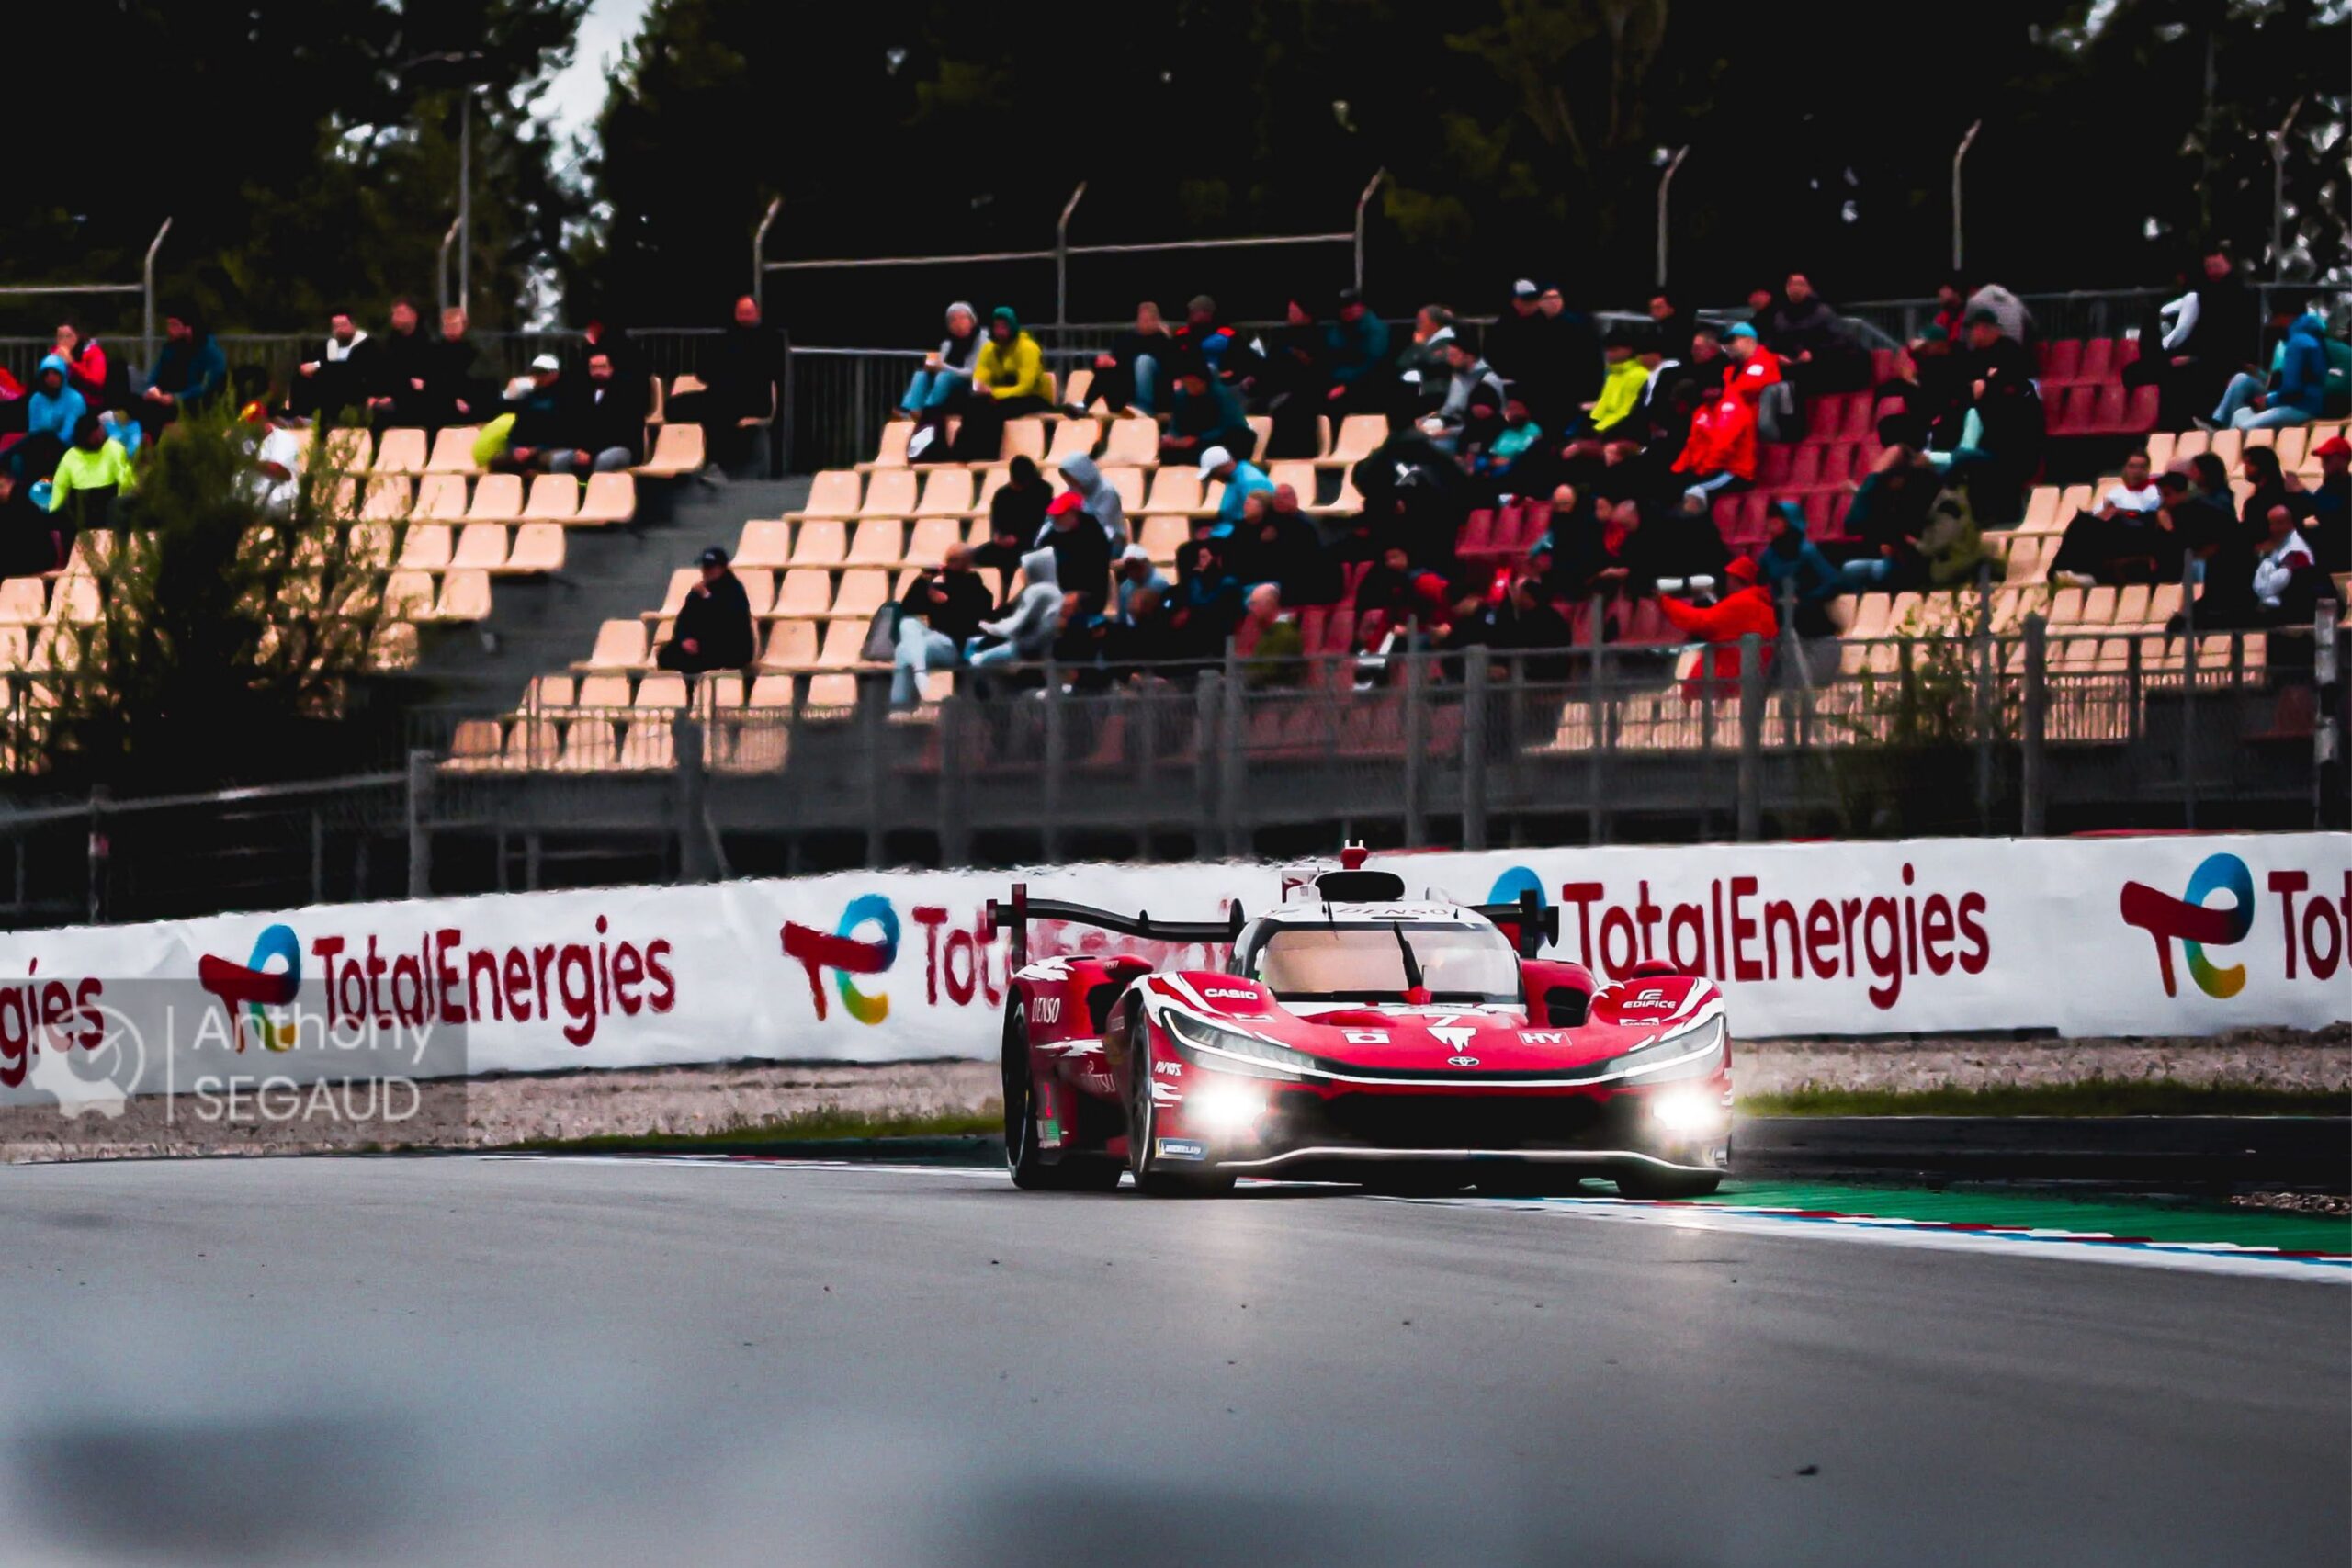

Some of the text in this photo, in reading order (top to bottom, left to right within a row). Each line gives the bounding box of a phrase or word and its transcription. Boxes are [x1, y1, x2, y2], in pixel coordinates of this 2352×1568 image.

[1562, 863, 1990, 1010] TotalEnergies
[311, 914, 675, 1047] TotalEnergies
[1204, 988, 1259, 1000] CASIO
[1032, 997, 1061, 1024] DENSO
[1622, 1000, 1677, 1009] EDIFICE
